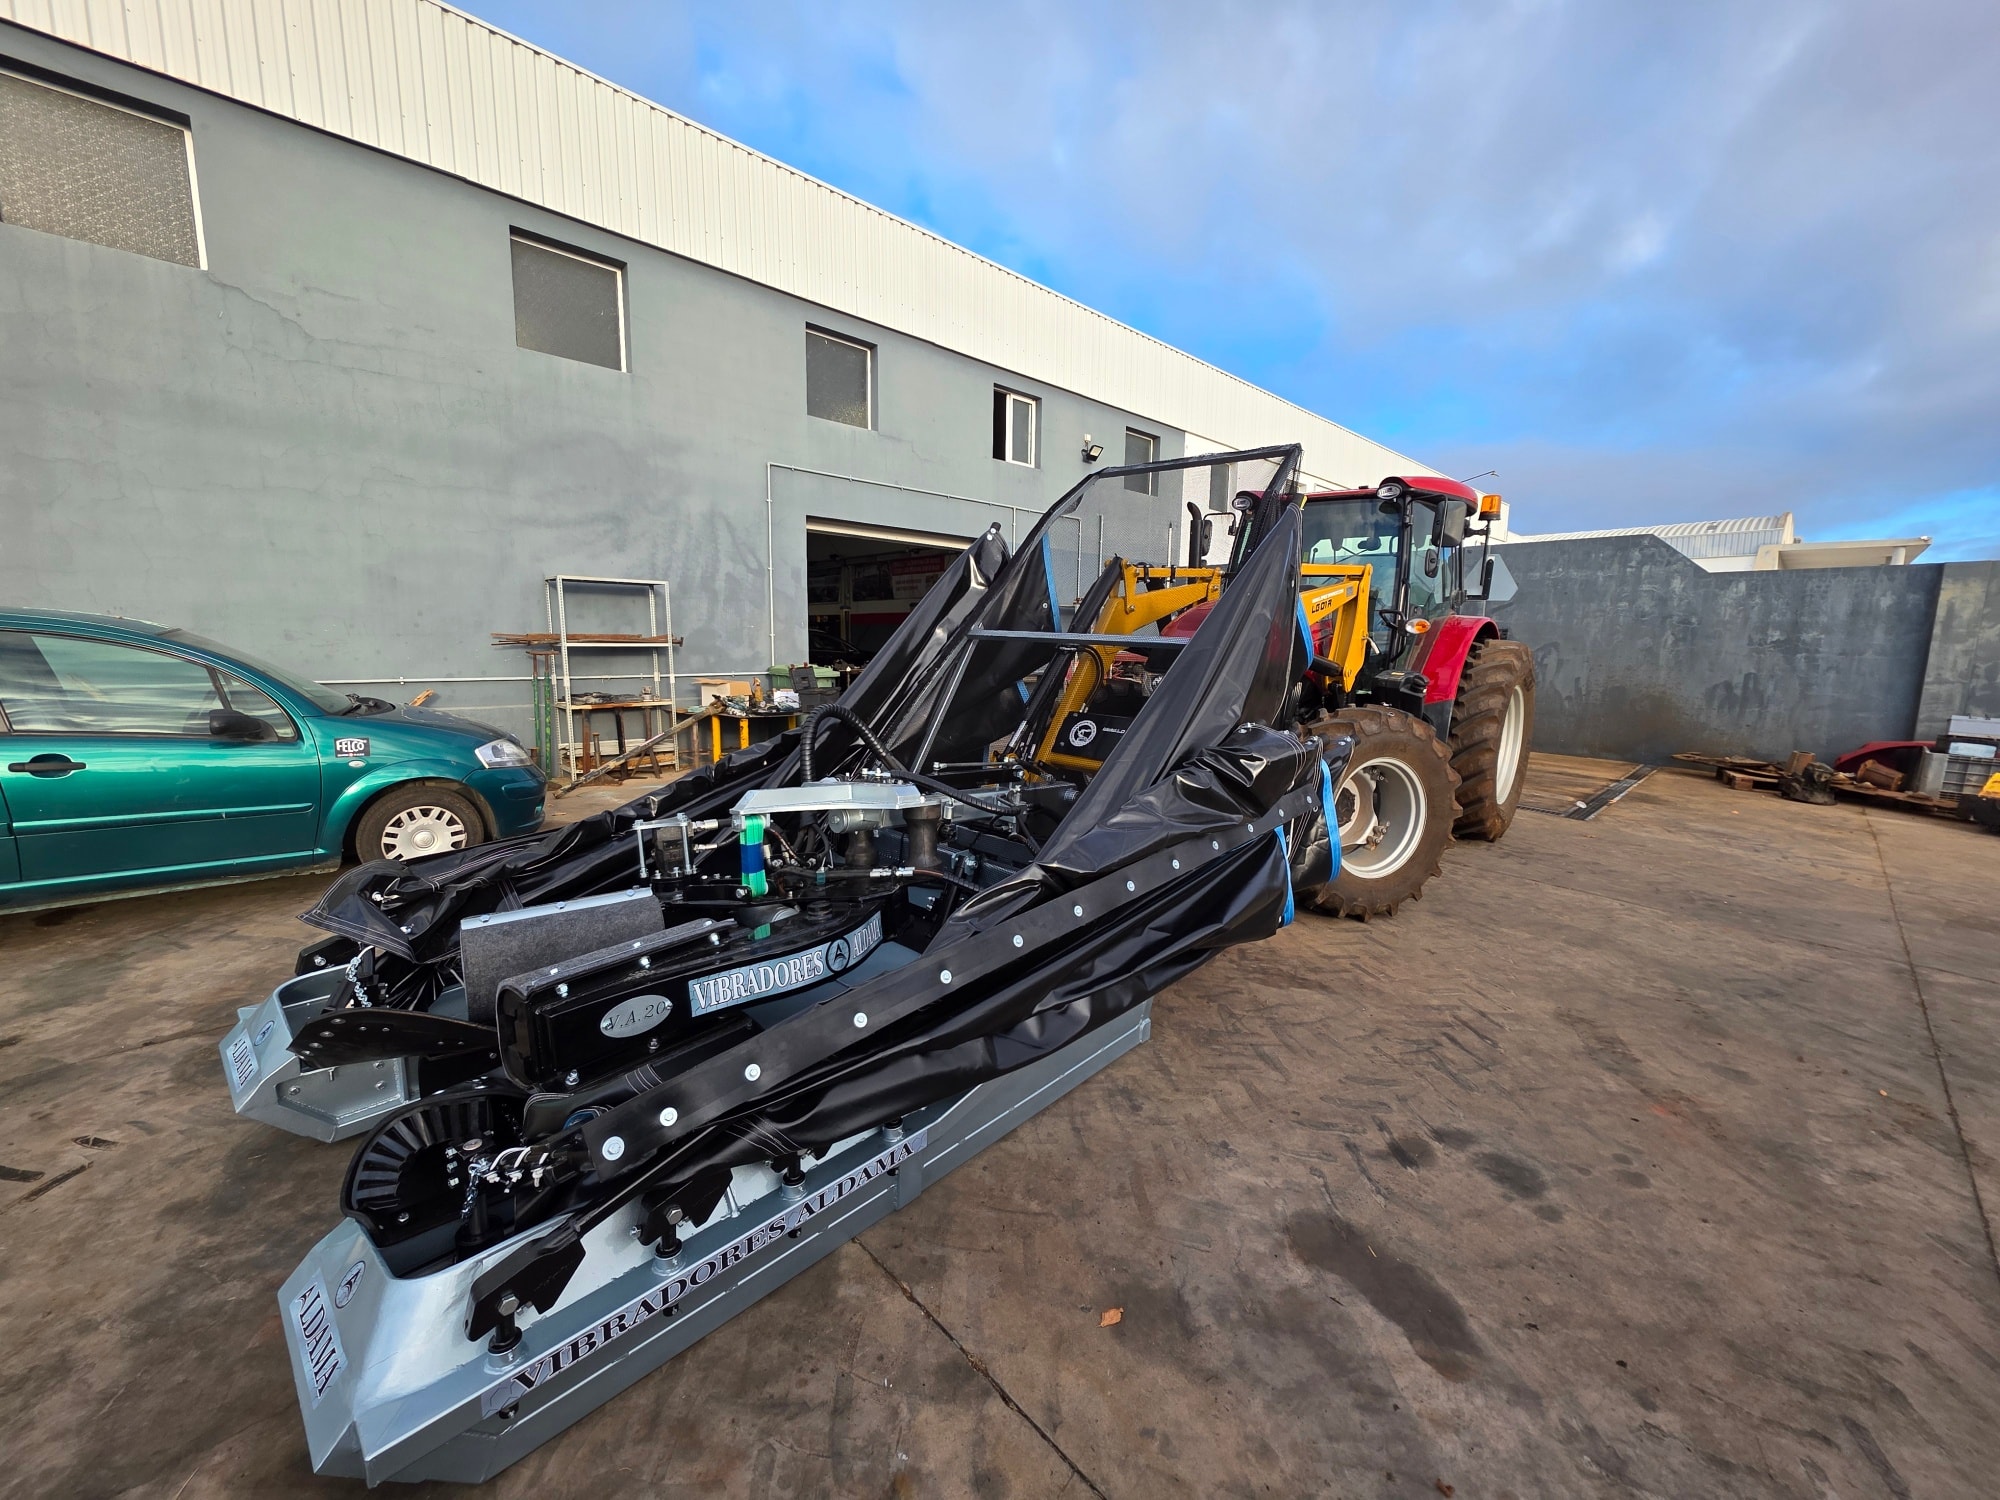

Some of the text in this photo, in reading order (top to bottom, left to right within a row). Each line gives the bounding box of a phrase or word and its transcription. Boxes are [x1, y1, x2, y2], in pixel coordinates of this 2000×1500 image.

[336, 739, 366, 752] FELCO
[694, 951, 824, 1009] VIBRADORES
[853, 919, 880, 960] ALDAMA
[512, 1142, 913, 1391] VIBRADORES ALDAMA
[300, 1284, 339, 1397] ALDAMA
